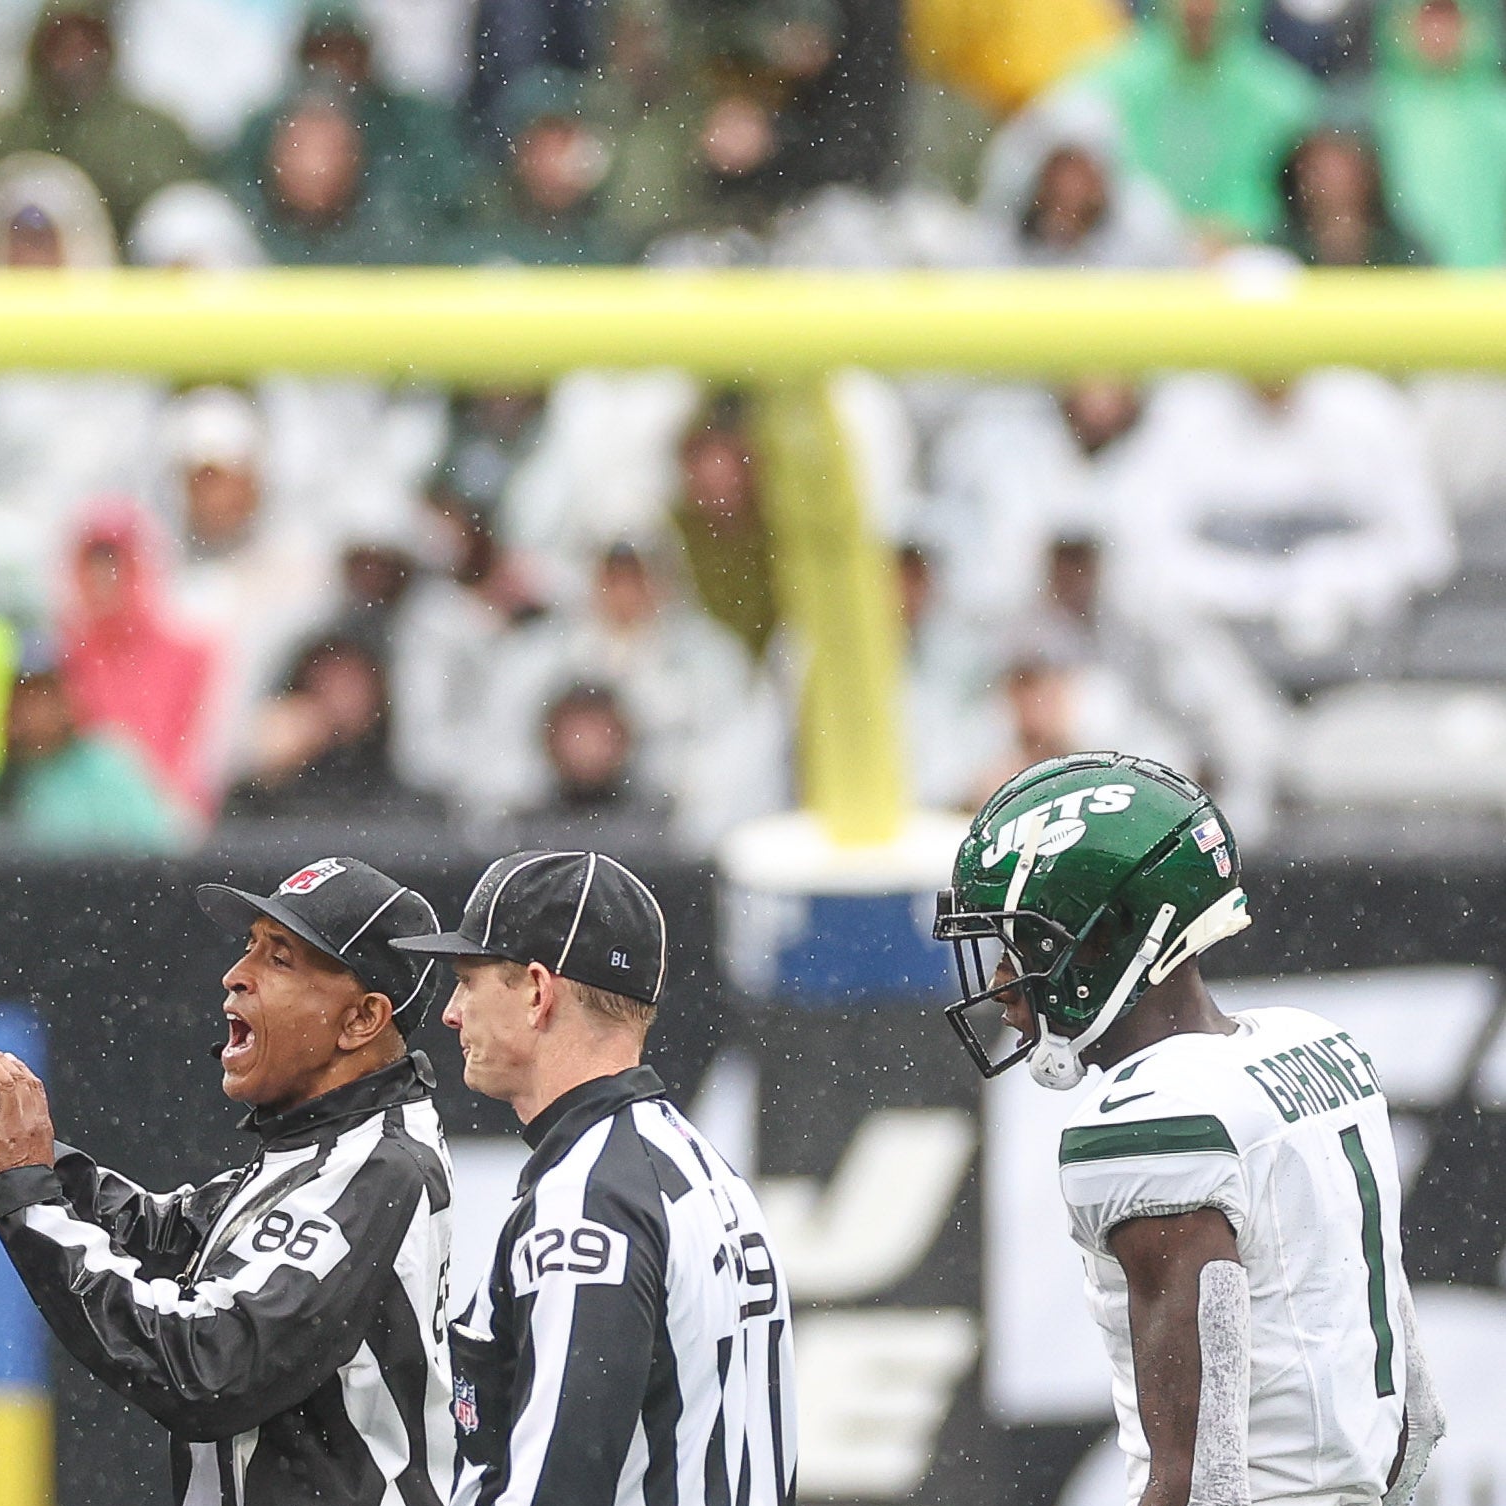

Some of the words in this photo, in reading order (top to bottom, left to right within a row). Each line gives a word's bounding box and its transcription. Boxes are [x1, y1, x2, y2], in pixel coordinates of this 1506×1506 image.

[611, 951, 630, 969] BL
[252, 1210, 333, 1261] 86
[519, 1228, 611, 1284] 129
[1339, 1124, 1395, 1398] 1
